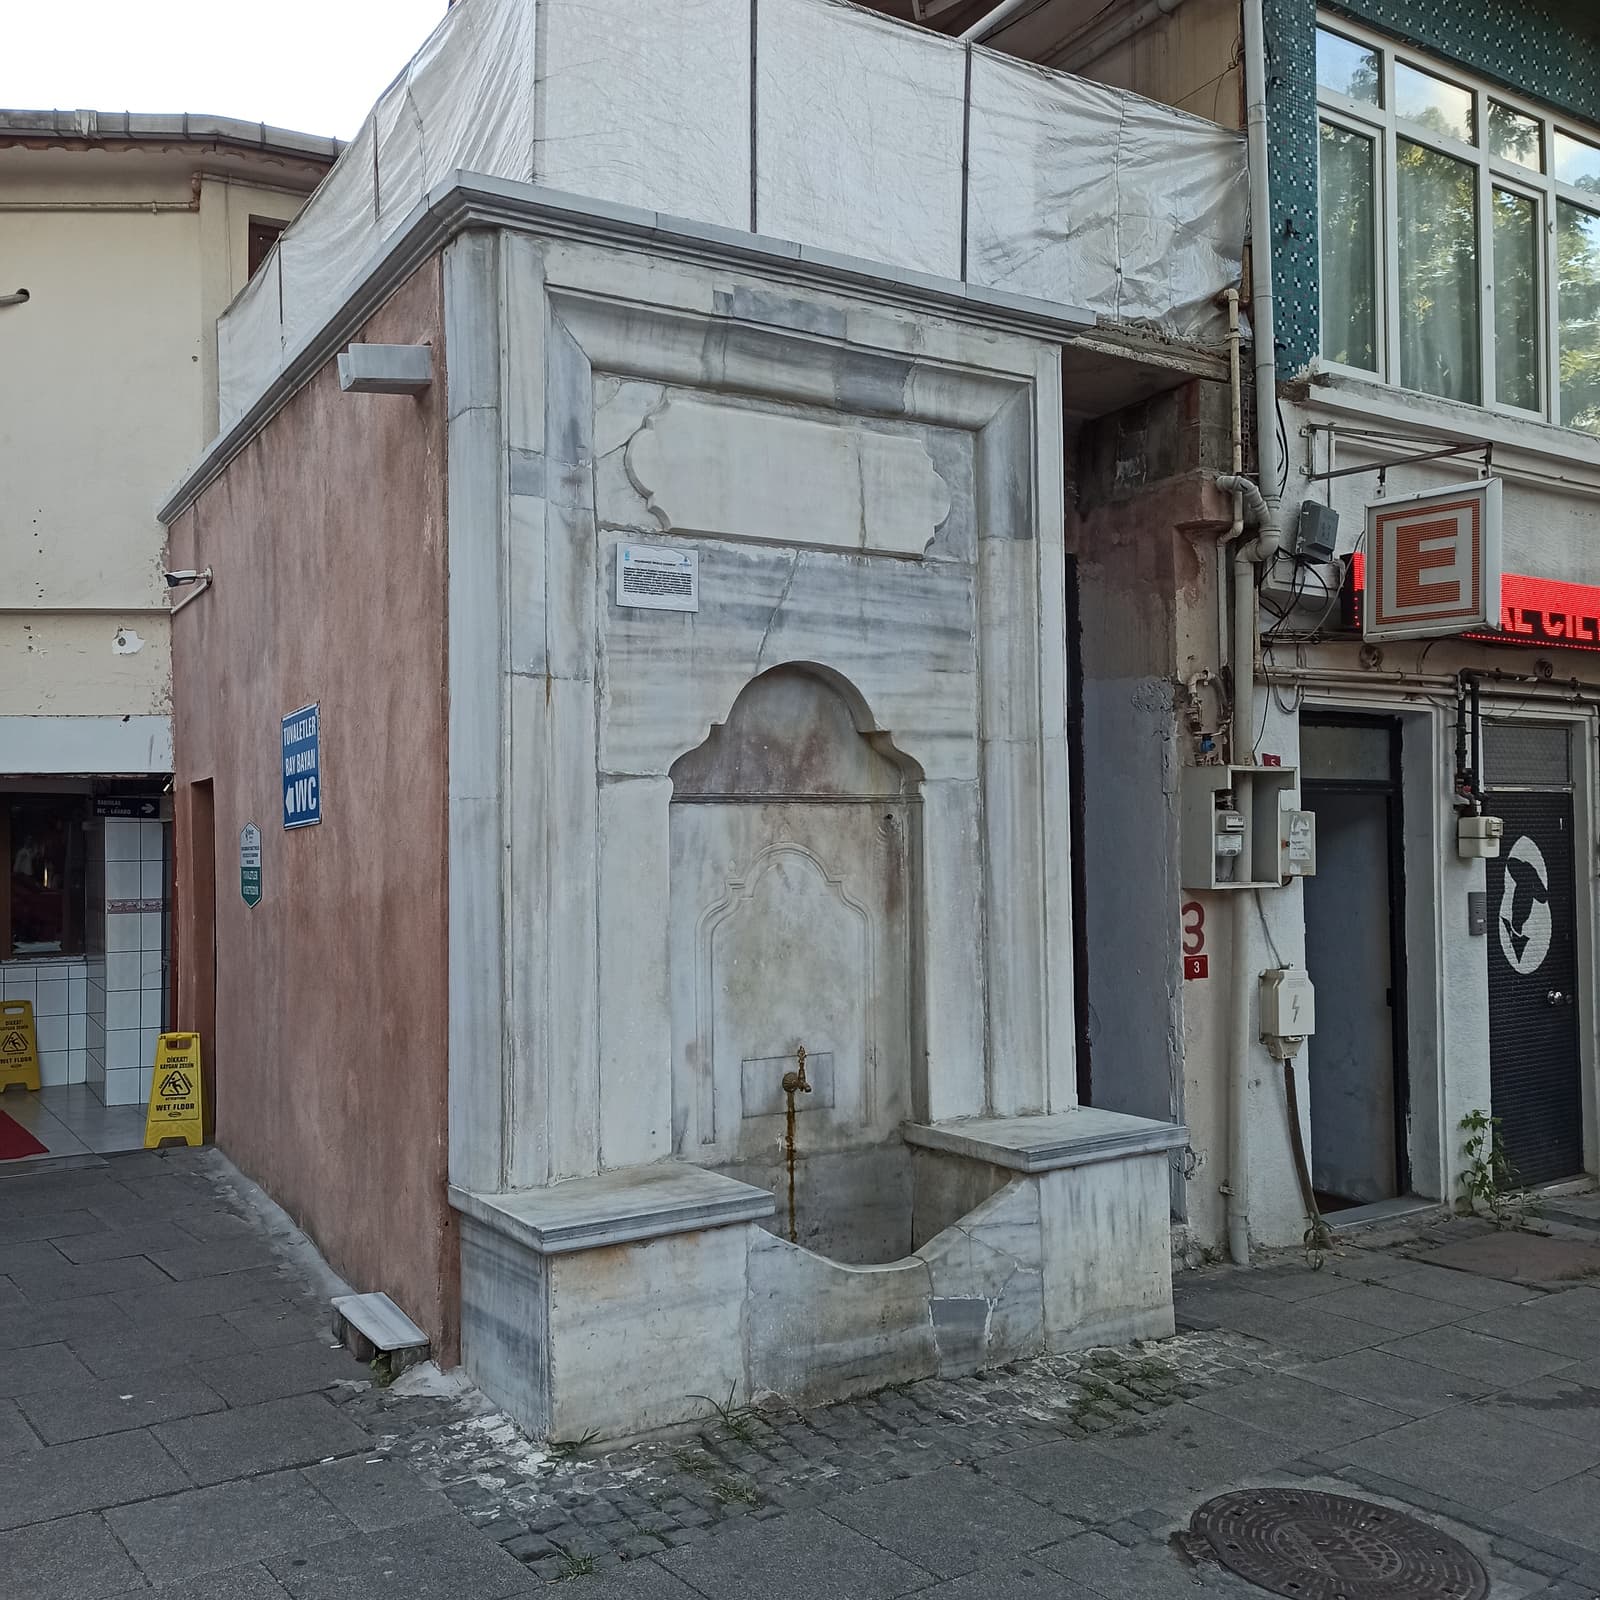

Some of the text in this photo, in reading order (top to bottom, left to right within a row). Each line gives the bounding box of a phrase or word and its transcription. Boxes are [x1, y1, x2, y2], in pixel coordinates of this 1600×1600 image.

[1396, 518, 1460, 608] E
[283, 716, 317, 747] TUVALETLER
[285, 748, 316, 777] BAY BAYAN
[295, 776, 317, 813] WC
[1181, 901, 1205, 955] 3
[1193, 960, 1200, 974] 3
[156, 1102, 195, 1111] WET FLOOR
